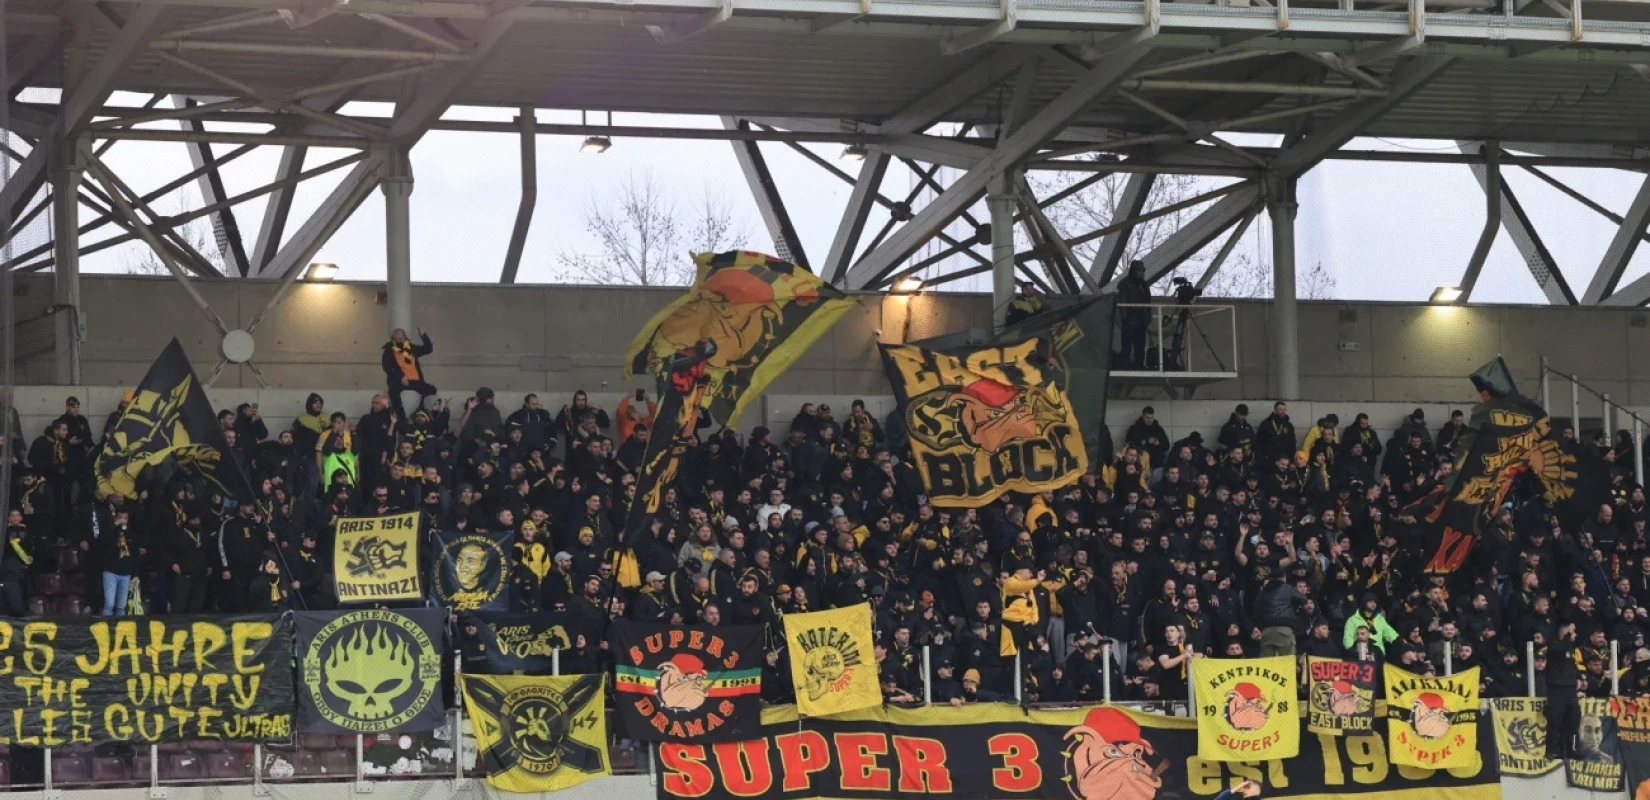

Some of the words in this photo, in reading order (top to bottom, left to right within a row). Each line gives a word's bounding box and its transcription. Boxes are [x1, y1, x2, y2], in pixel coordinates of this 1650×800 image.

[886, 337, 1042, 399] EAST
[923, 425, 1081, 497] BLOCK
[339, 520, 375, 535] ARIS
[380, 516, 414, 531] 1914
[338, 576, 418, 596] ANTINAZI
[75, 621, 273, 674] JAHRE
[311, 624, 338, 651] ARIS
[340, 611, 400, 626] ATHENS
[402, 620, 431, 649] CLUB
[498, 624, 532, 636] ARIS
[14, 675, 90, 708] THE
[126, 672, 261, 710] UNITY
[1209, 666, 1288, 689] ΚΕΝΤΡΙΚΟΣ
[103, 702, 223, 741] GUTE
[223, 712, 291, 738] ULTRAS
[313, 692, 340, 722] ΟΠΟΥ
[341, 719, 389, 731] ΠΑΙΖΕΙ
[404, 688, 432, 718] ΘΕΟΣ
[633, 697, 735, 738] DRAMAS
[1203, 705, 1217, 717] 19
[1310, 712, 1337, 728] EAST
[1341, 715, 1373, 730] BLOCK
[660, 730, 952, 797] SUPER
[988, 732, 1043, 793] 3
